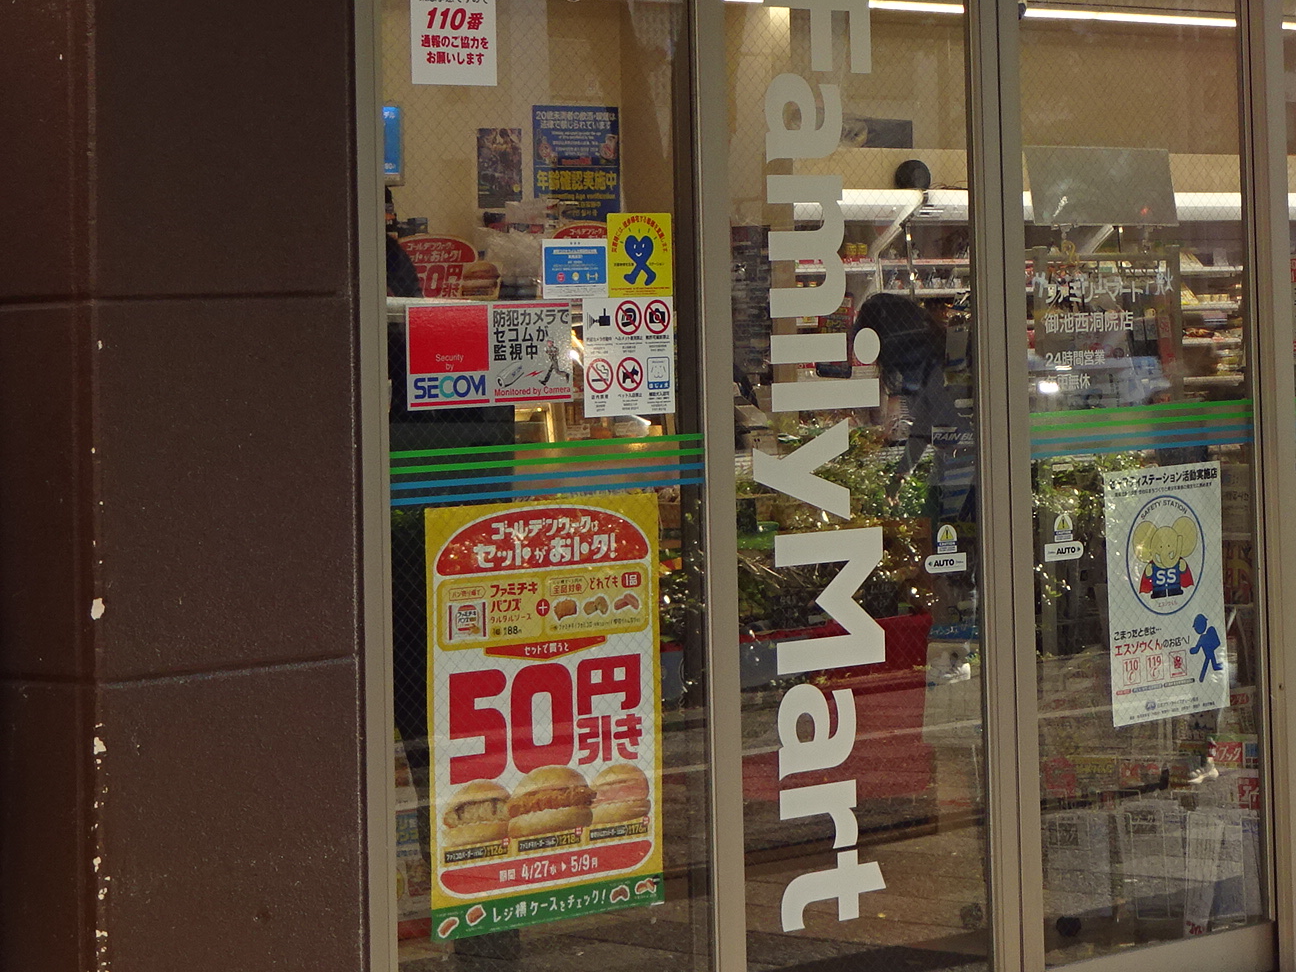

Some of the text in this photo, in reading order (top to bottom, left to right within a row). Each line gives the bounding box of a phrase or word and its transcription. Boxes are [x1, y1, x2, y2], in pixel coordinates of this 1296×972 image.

[426, 6, 485, 31] 110番
[420, 34, 489, 51] 通報のご協力を
[426, 51, 485, 66] お願いします
[493, 309, 569, 328] 防犯カメラで
[1044, 311, 1134, 334] 御池西洞院店
[493, 326, 549, 344] セコムが
[435, 353, 464, 364] Security
[493, 343, 538, 361] 監視中
[1045, 350, 1106, 367] 24時間営業
[445, 363, 454, 371] by
[414, 374, 486, 400] SECOM
[494, 385, 571, 397] Monitored by Camera
[1140, 500, 1188, 520] SAFETY STATION
[473, 532, 617, 568] セットがおトク!
[1056, 546, 1077, 555] AUTO
[933, 559, 955, 567] AUTO
[589, 575, 618, 590] どれでも
[1156, 569, 1177, 585] SS
[489, 581, 538, 598] ファミチキ
[489, 598, 522, 614] バンズ
[489, 613, 532, 624] タルタルソース
[524, 642, 570, 656] セットで買うと
[1124, 654, 1162, 672] 110 119
[499, 869, 516, 882] 期間
[492, 889, 607, 923] レジ横ケースをチェック!
